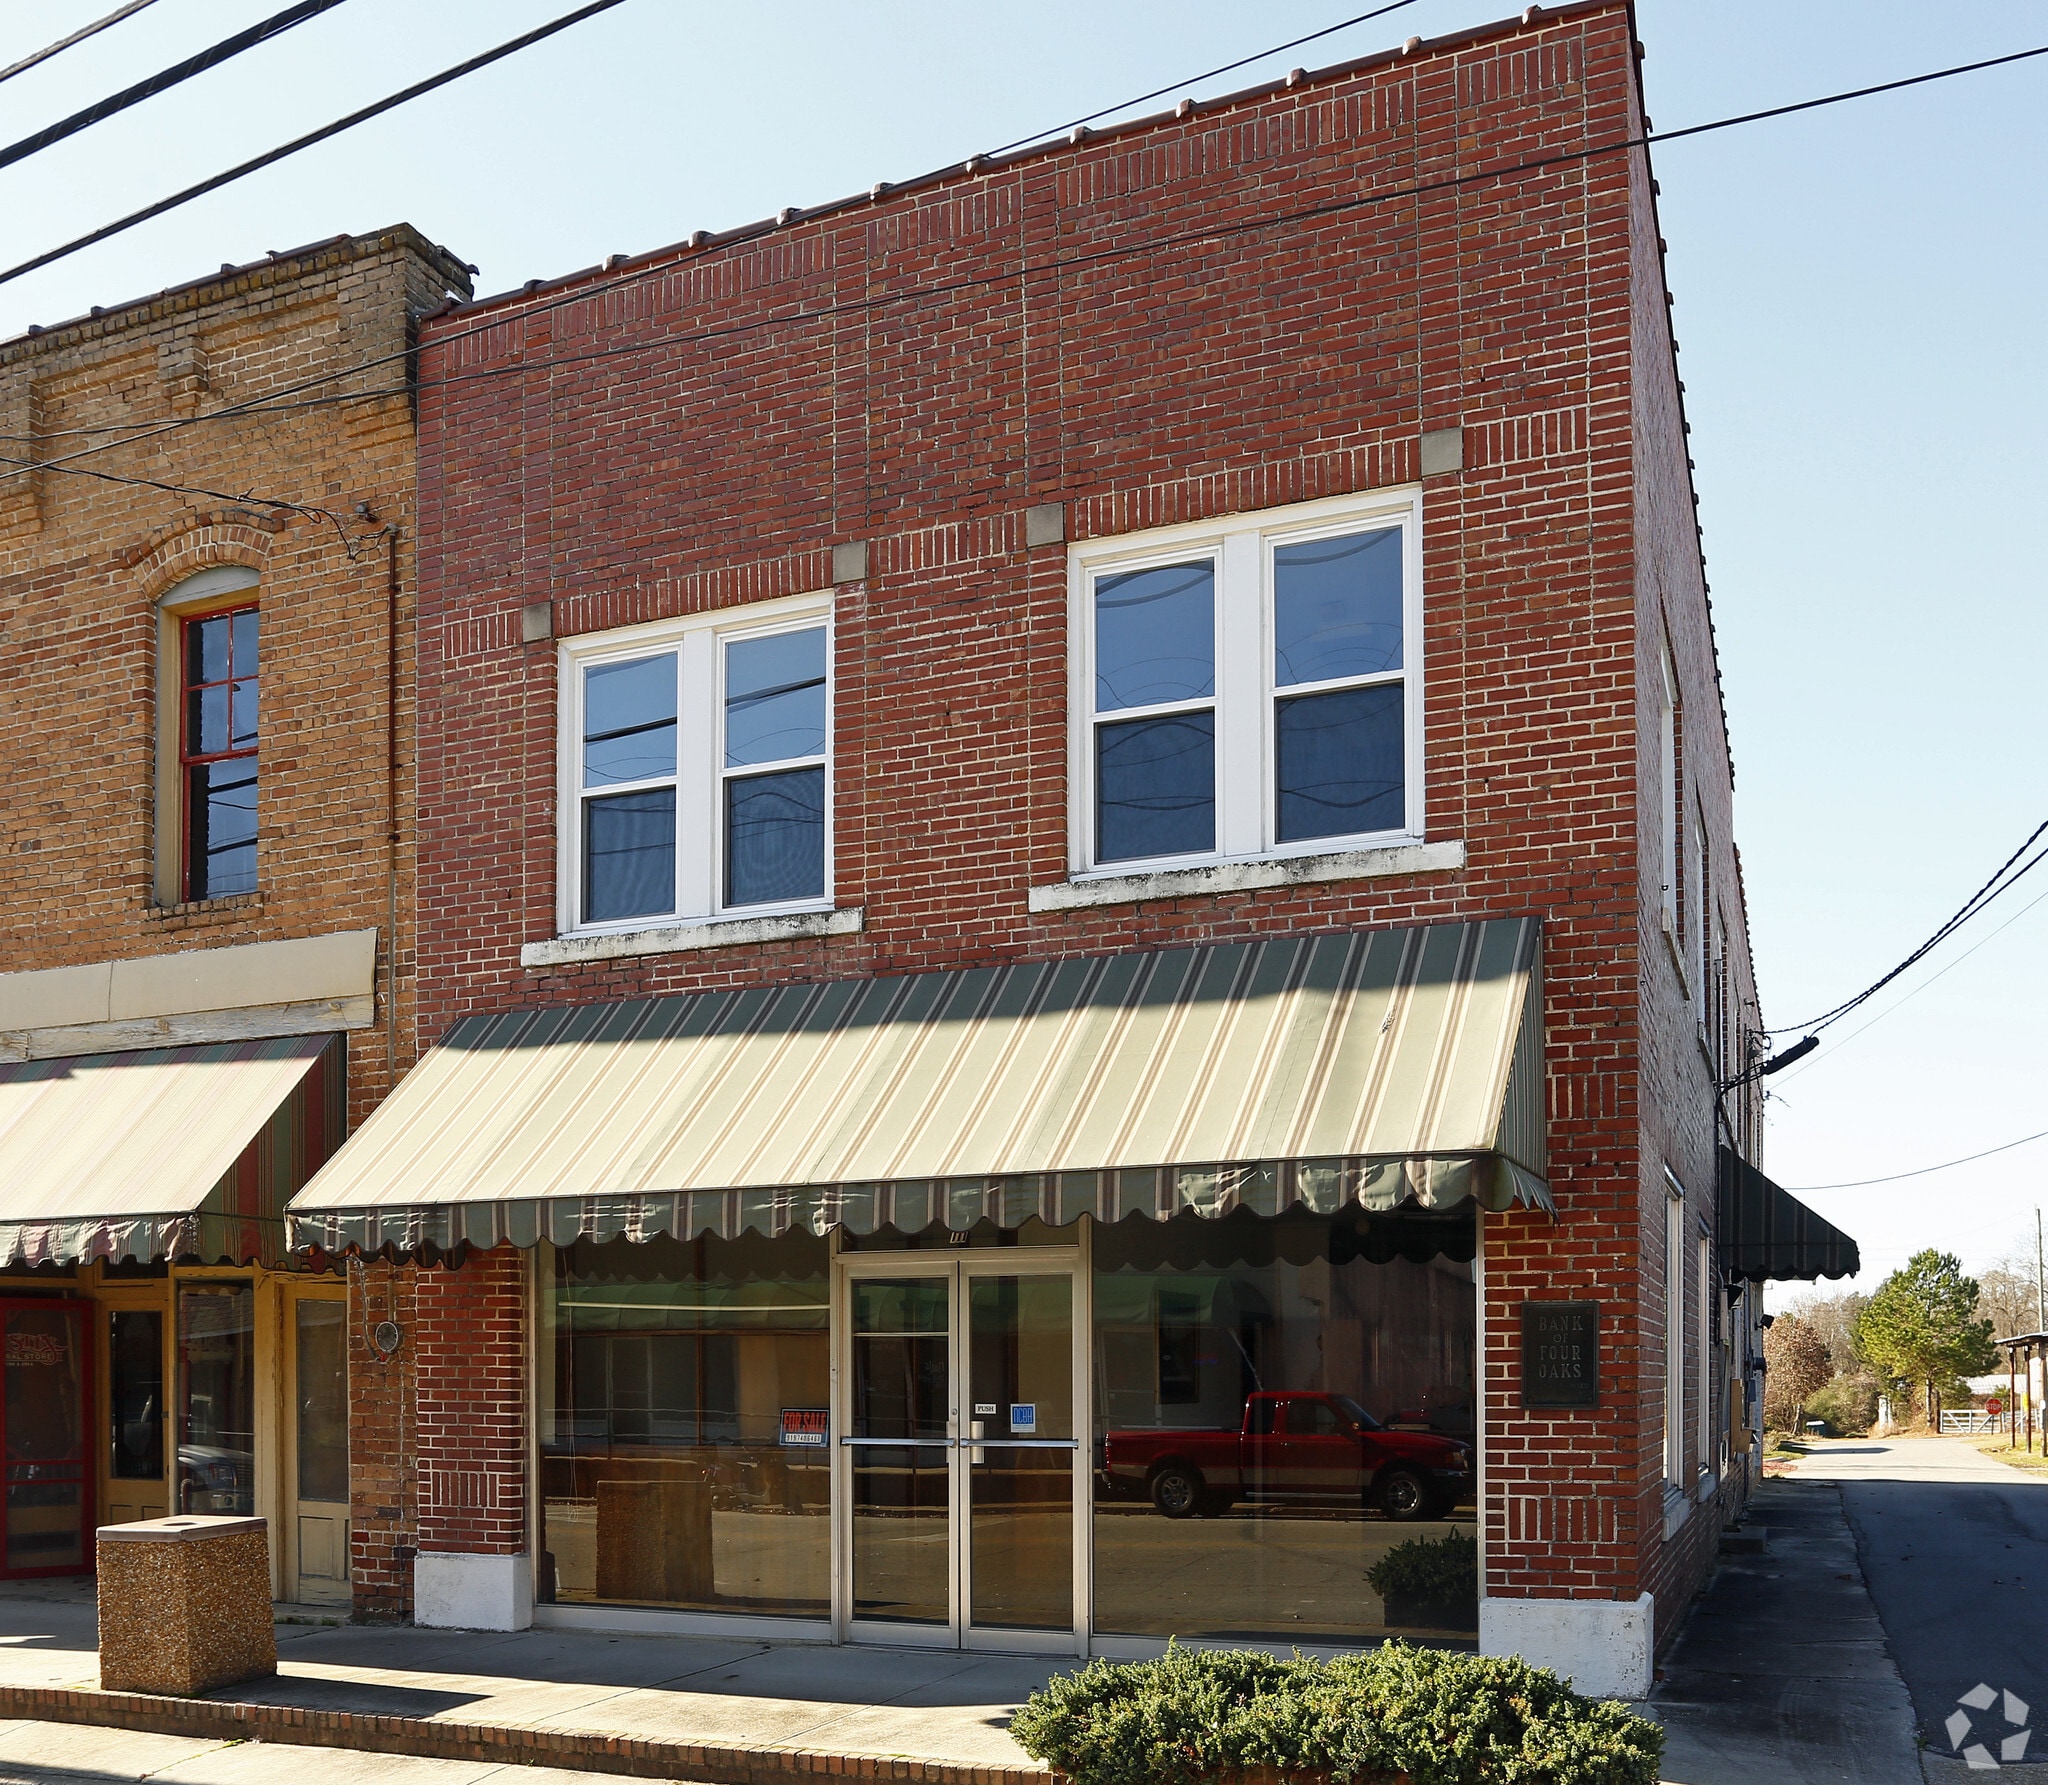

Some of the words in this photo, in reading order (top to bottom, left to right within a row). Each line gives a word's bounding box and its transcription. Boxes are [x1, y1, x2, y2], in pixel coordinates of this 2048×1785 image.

[1539, 1315, 1584, 1331] BANK
[1552, 1333, 1569, 1343] OF
[1539, 1345, 1582, 1360] FOUR
[1539, 1363, 1582, 1379] OAKS
[783, 1412, 802, 1432] FOR
[803, 1412, 827, 1433] SALE
